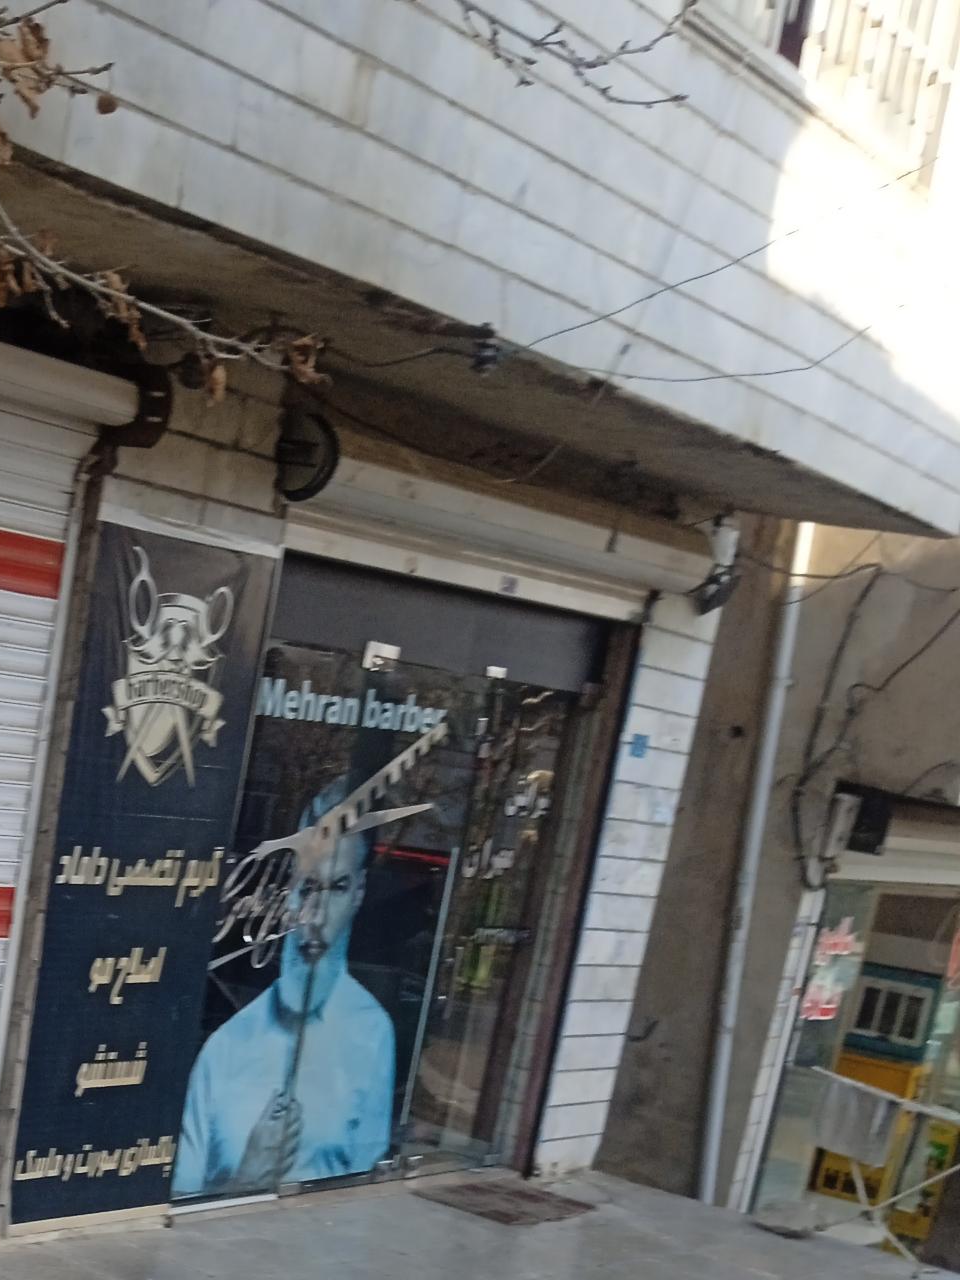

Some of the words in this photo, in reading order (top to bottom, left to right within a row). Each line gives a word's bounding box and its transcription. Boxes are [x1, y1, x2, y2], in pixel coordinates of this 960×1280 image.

[255, 676, 360, 726] Mehran
[362, 688, 448, 734] barber
[88, 957, 116, 993] مو
[109, 946, 167, 1005] اصلاح
[74, 1041, 148, 1098] شستشو
[14, 1147, 64, 1181] ماسک
[61, 1153, 74, 1182] و
[73, 1144, 122, 1177] صورت
